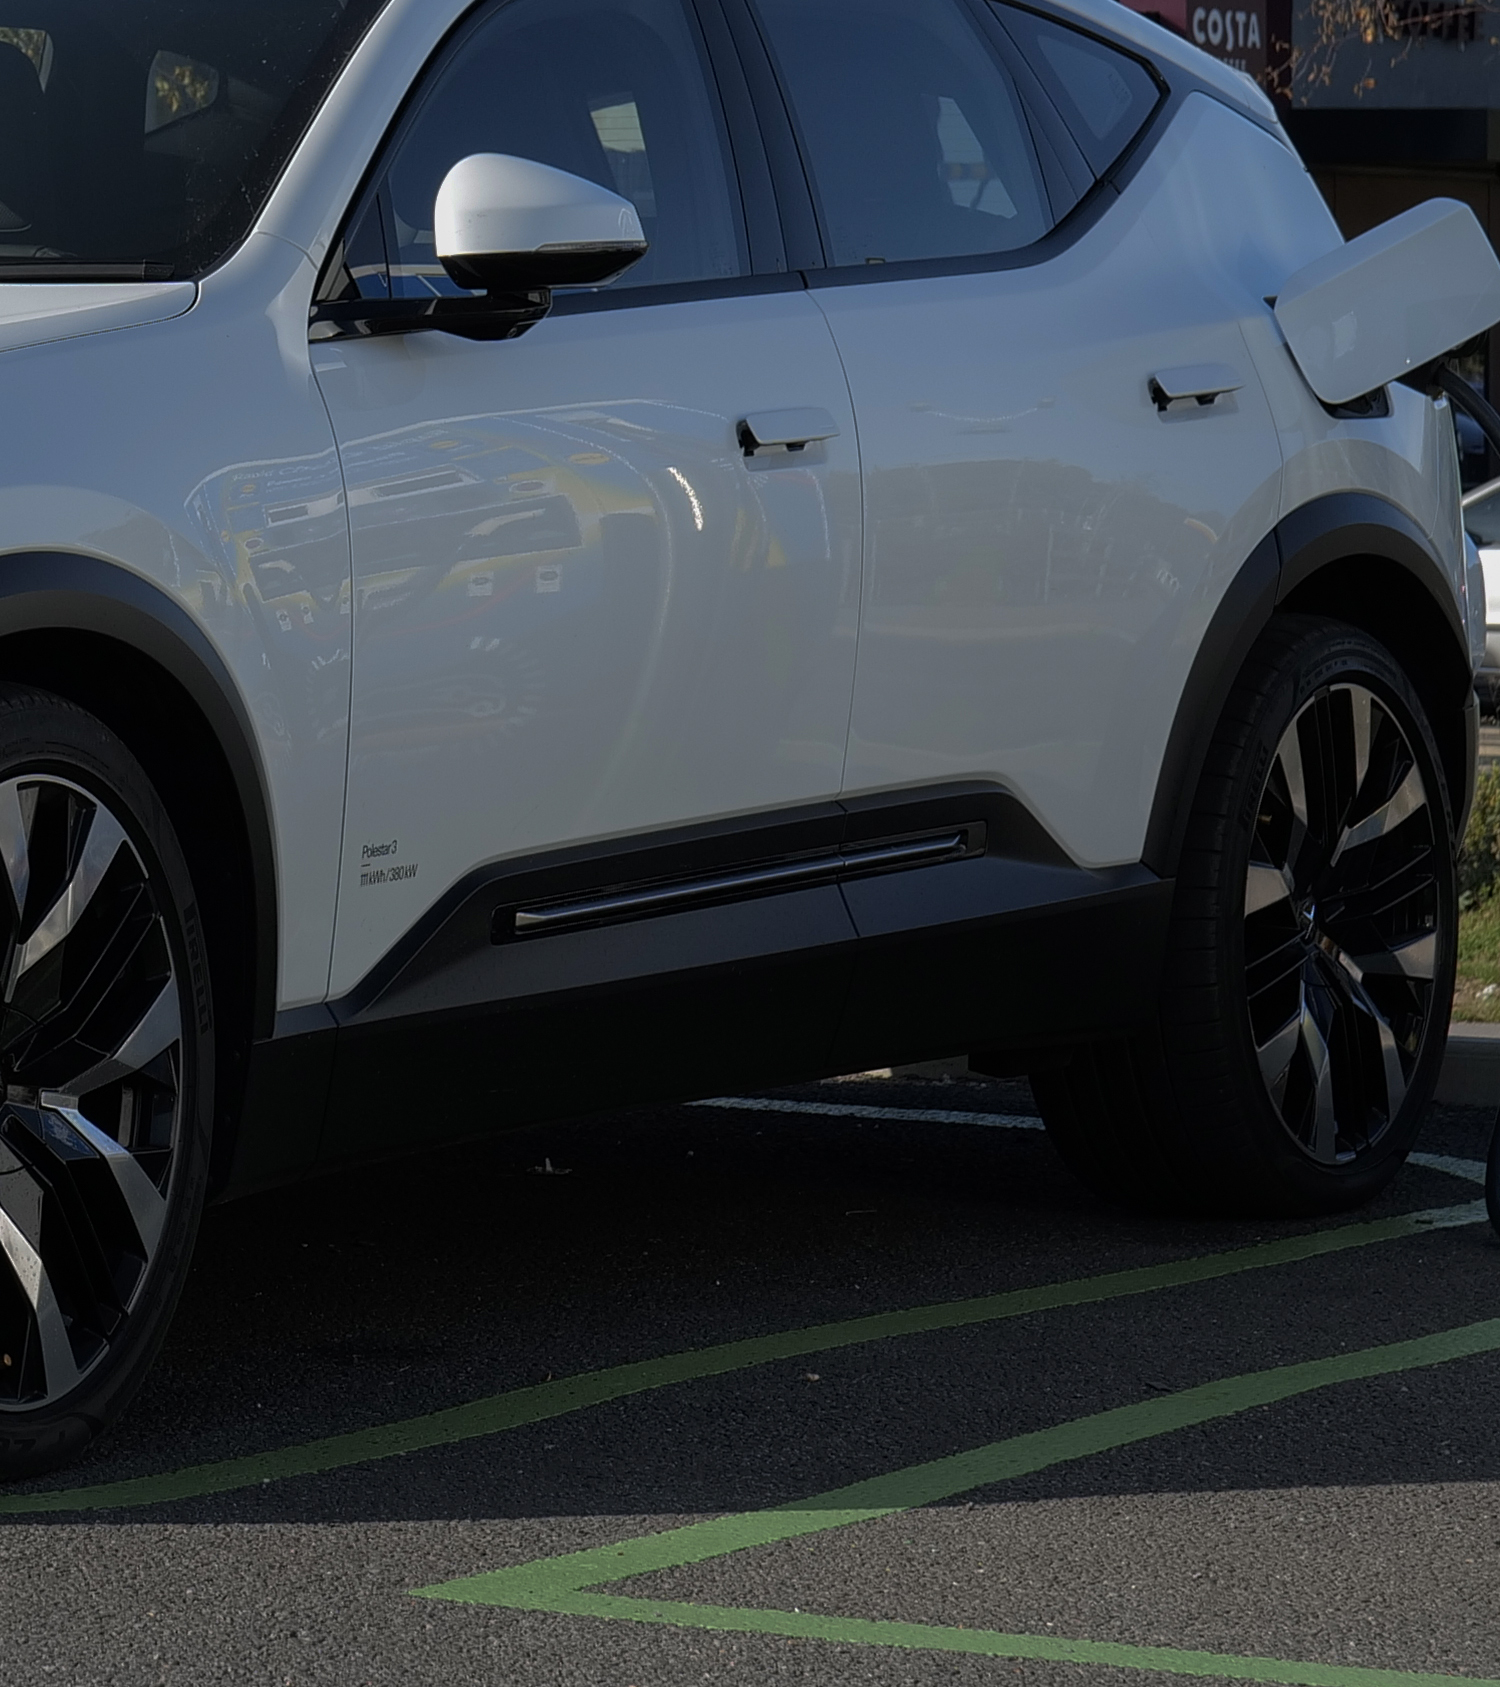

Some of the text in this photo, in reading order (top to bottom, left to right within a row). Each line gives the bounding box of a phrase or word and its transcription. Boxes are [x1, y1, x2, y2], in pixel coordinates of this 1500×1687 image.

[1192, 6, 1261, 53] COSTA
[362, 839, 398, 859] Polestar 3
